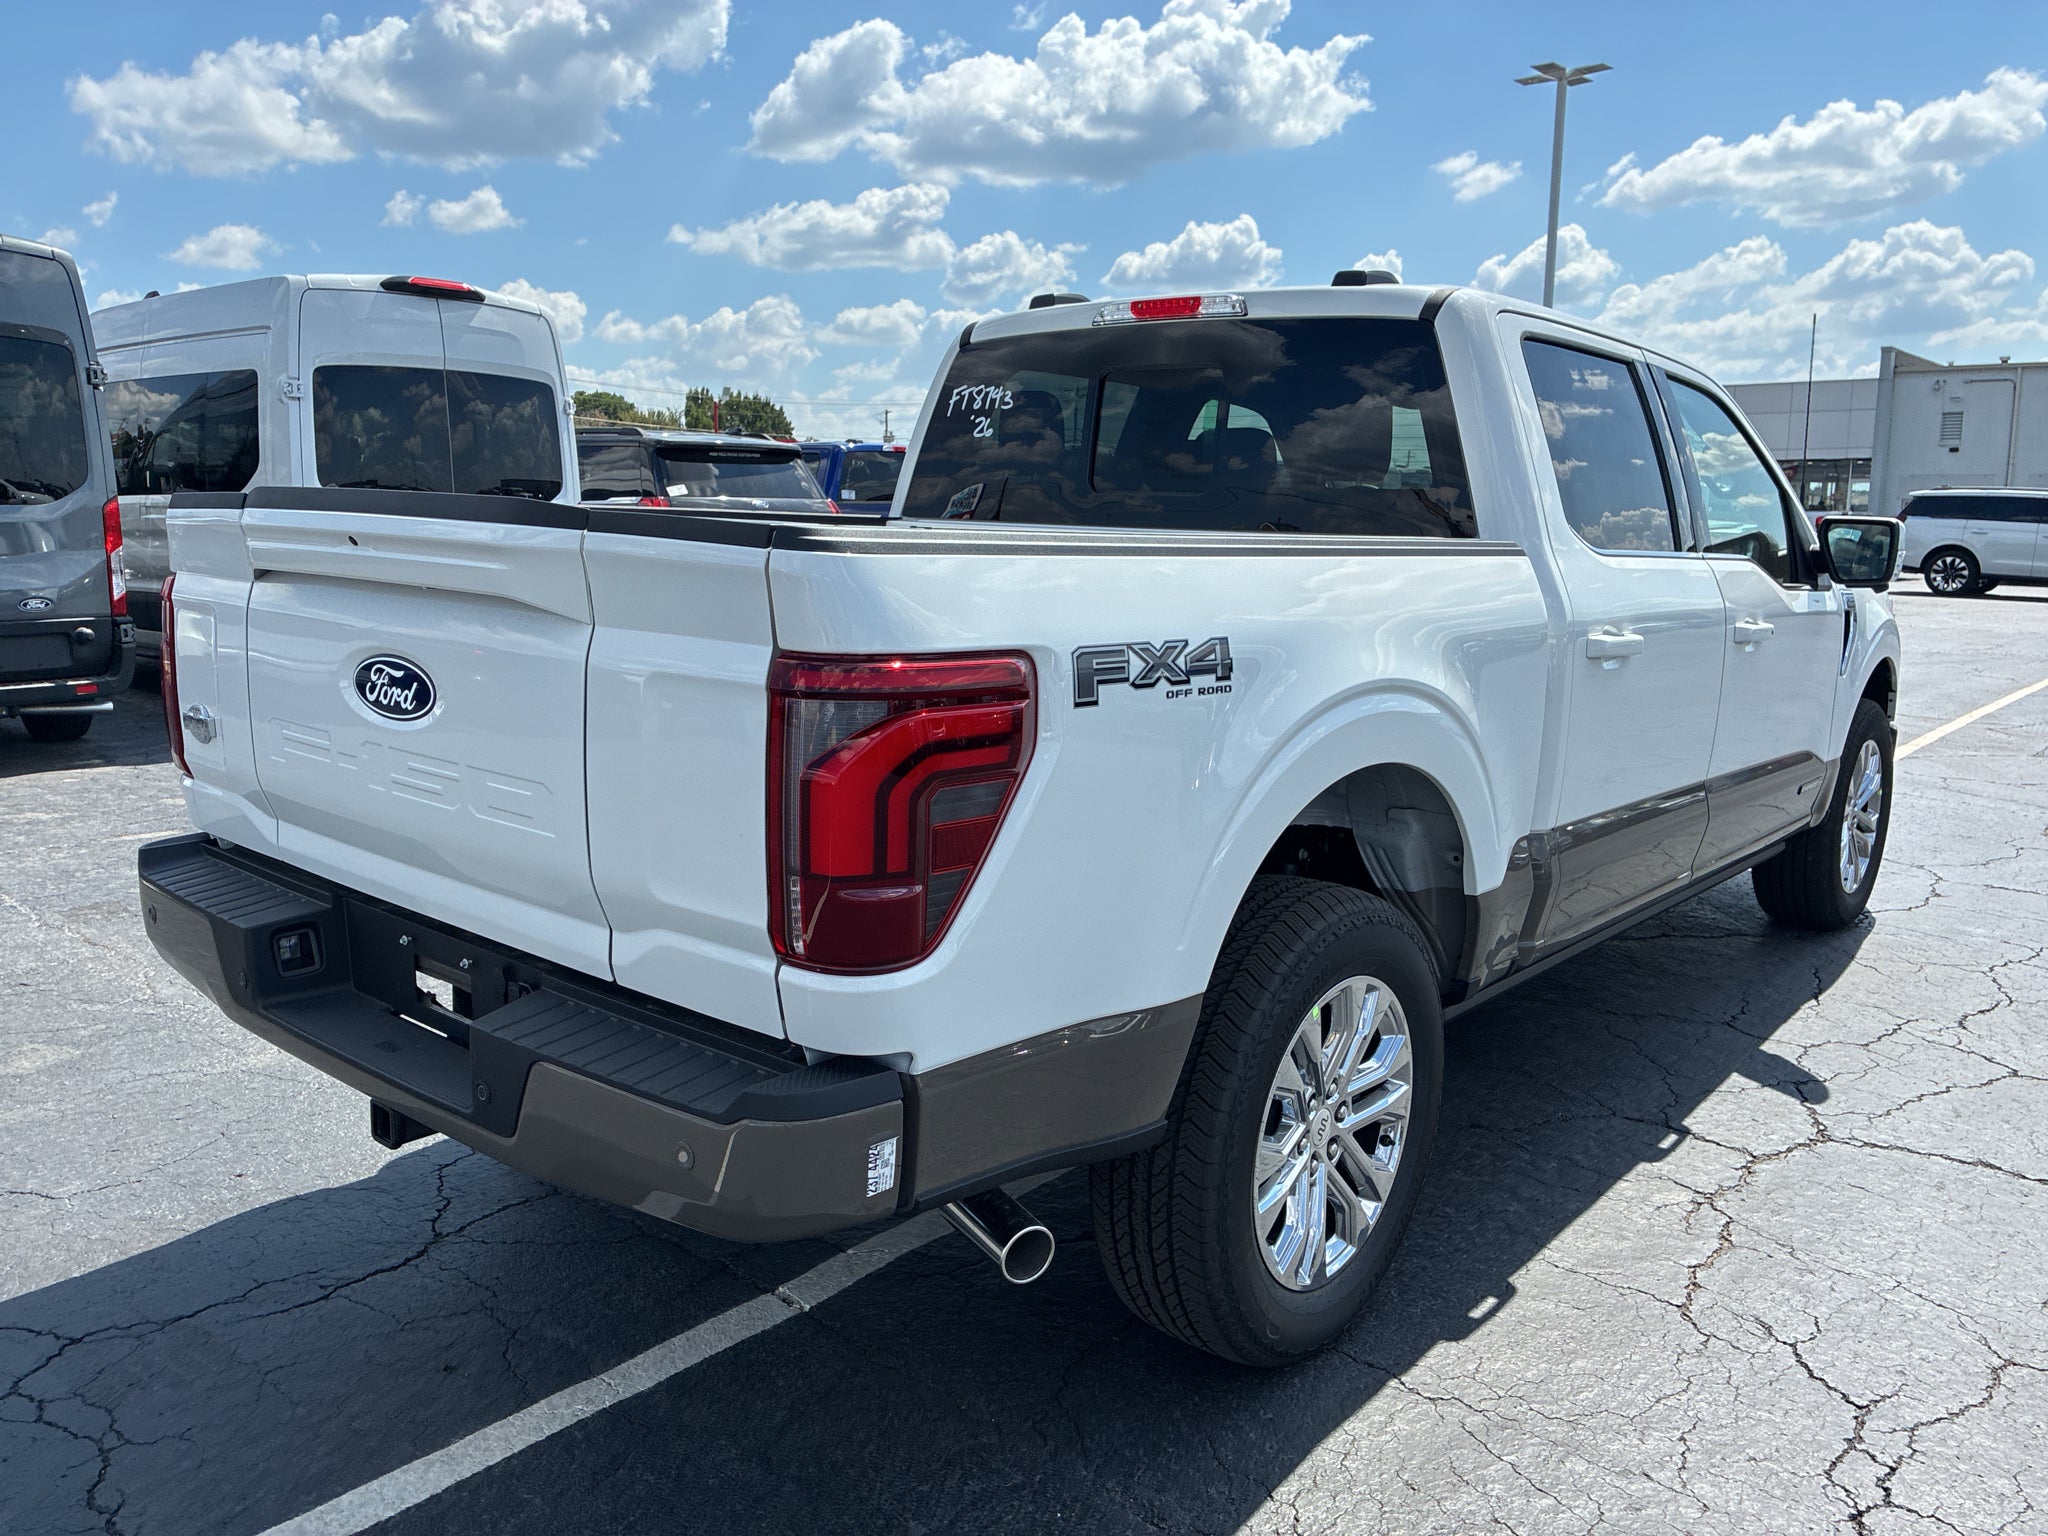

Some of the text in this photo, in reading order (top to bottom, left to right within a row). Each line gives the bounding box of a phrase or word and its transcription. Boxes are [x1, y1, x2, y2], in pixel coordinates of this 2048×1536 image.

[366, 663, 418, 710] Ford
[1071, 636, 1233, 709] FX4
[1166, 685, 1232, 699] OFF ROAD
